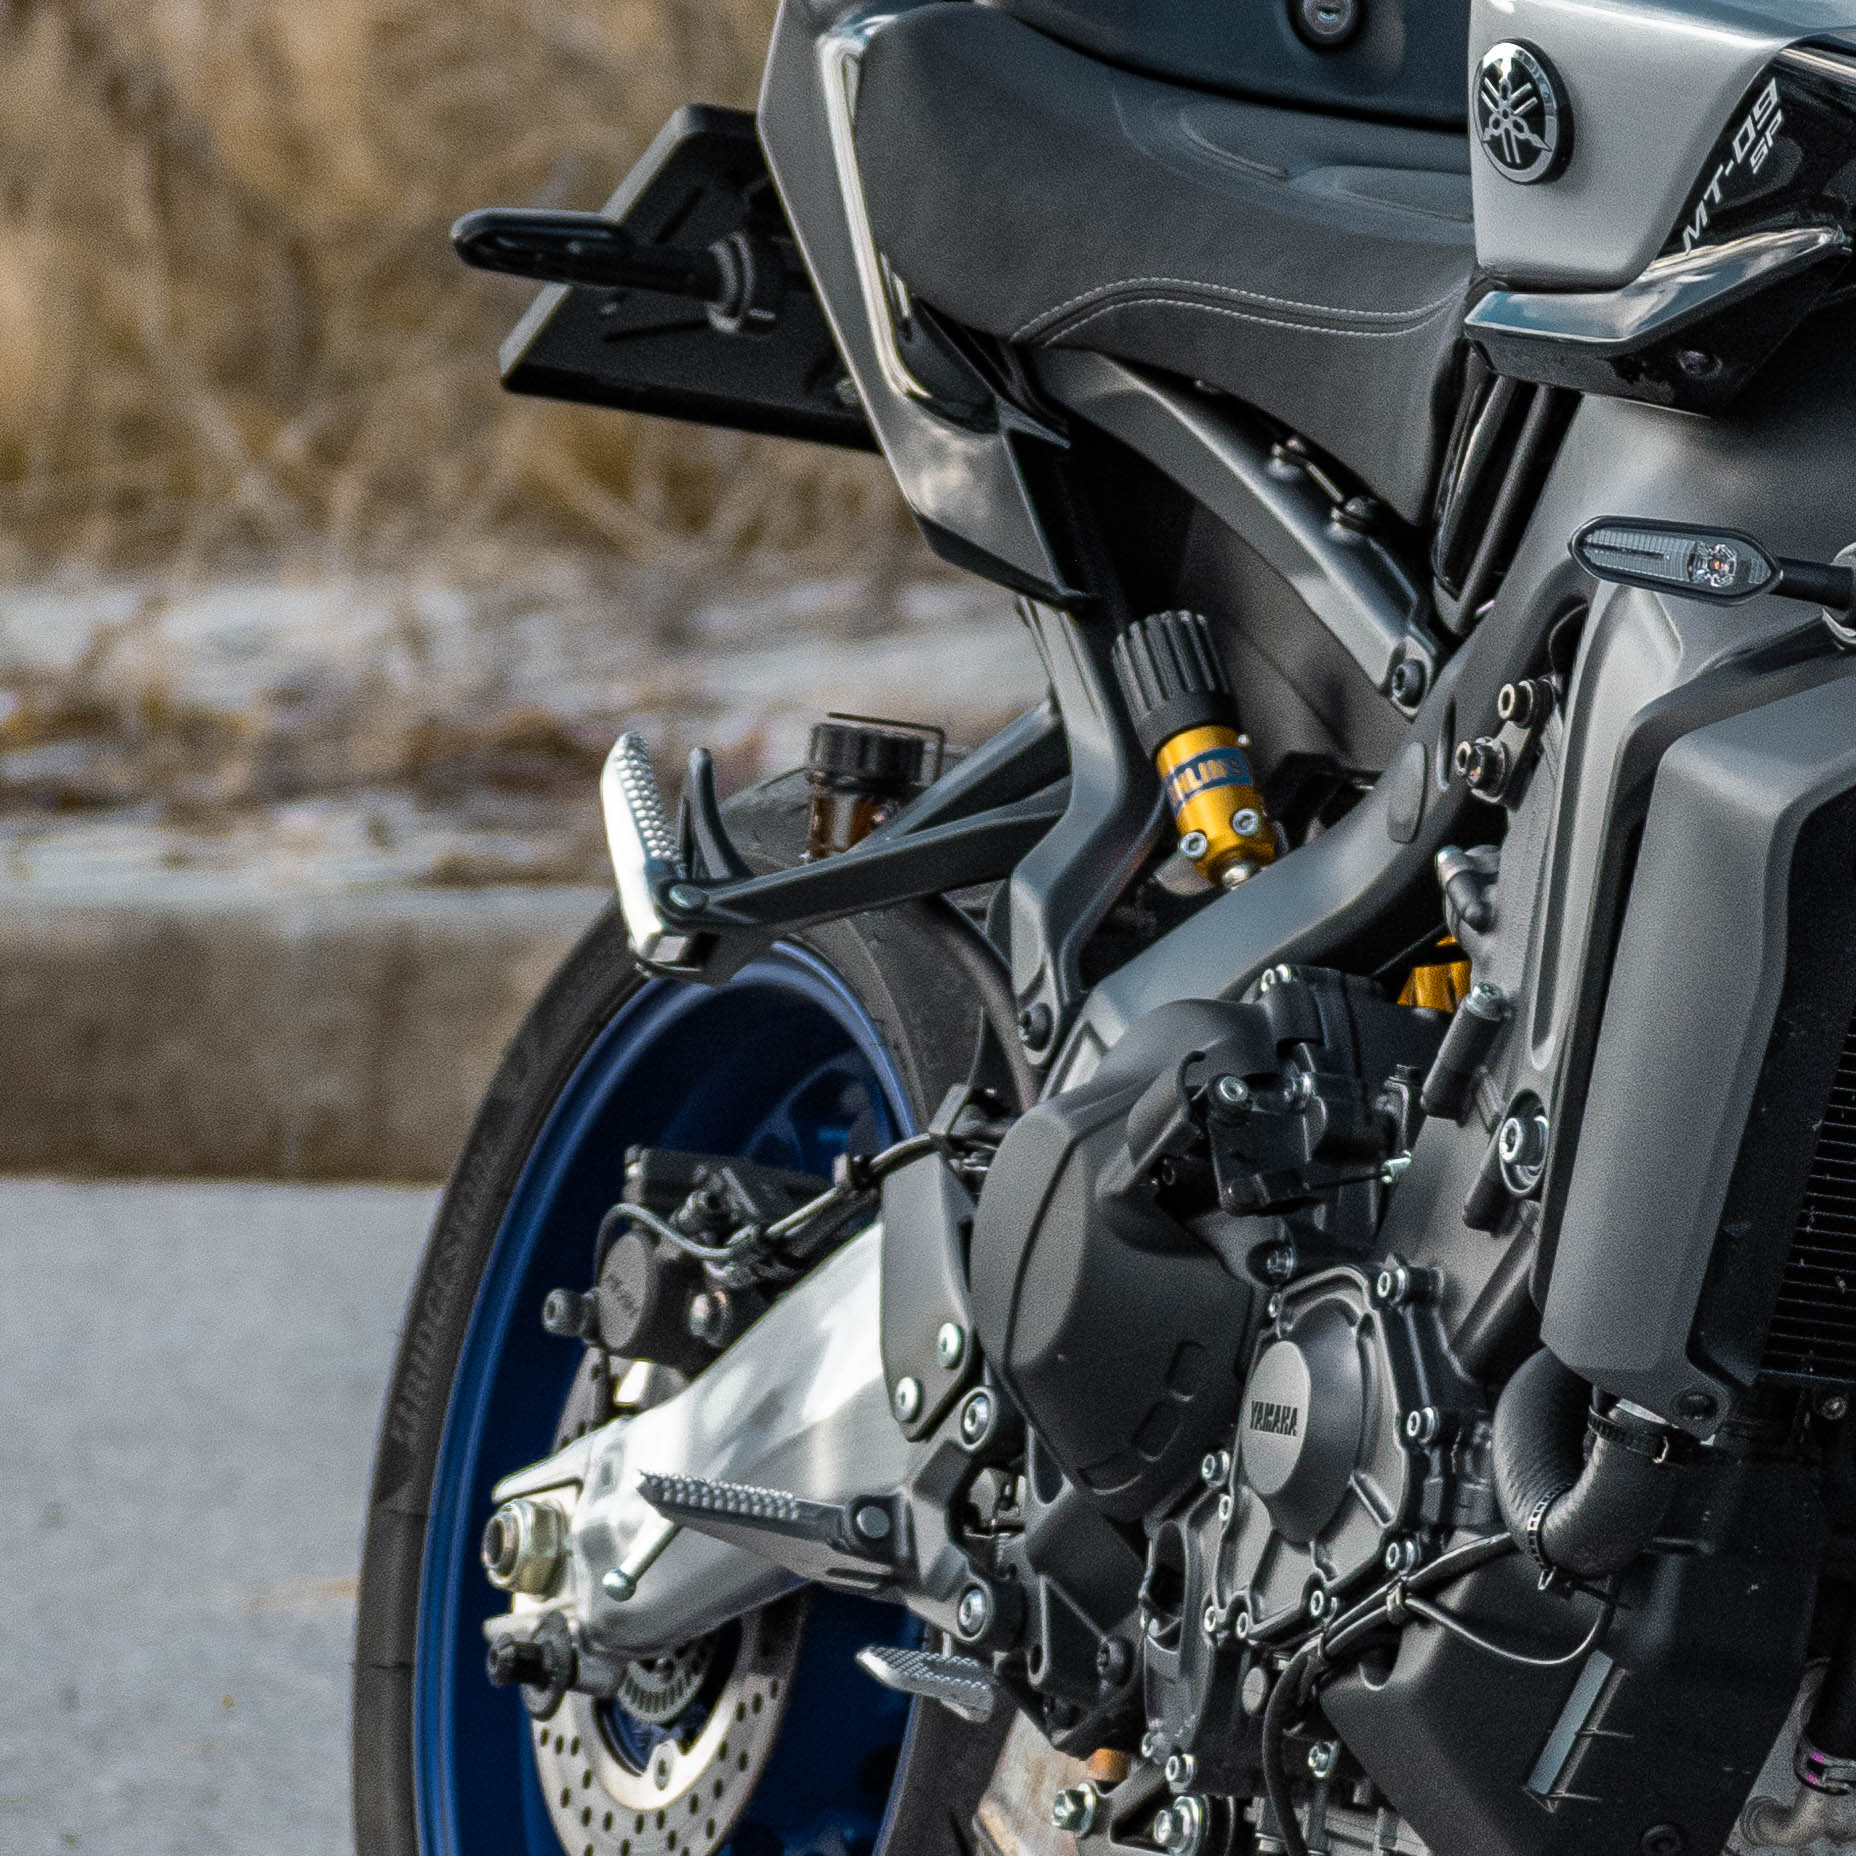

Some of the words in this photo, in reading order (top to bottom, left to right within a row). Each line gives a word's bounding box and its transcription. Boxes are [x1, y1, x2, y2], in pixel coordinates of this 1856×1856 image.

[1682, 76, 1780, 256] MT-09
[1749, 108, 1785, 175] SP
[1249, 1399, 1298, 1437] YAMAHA
